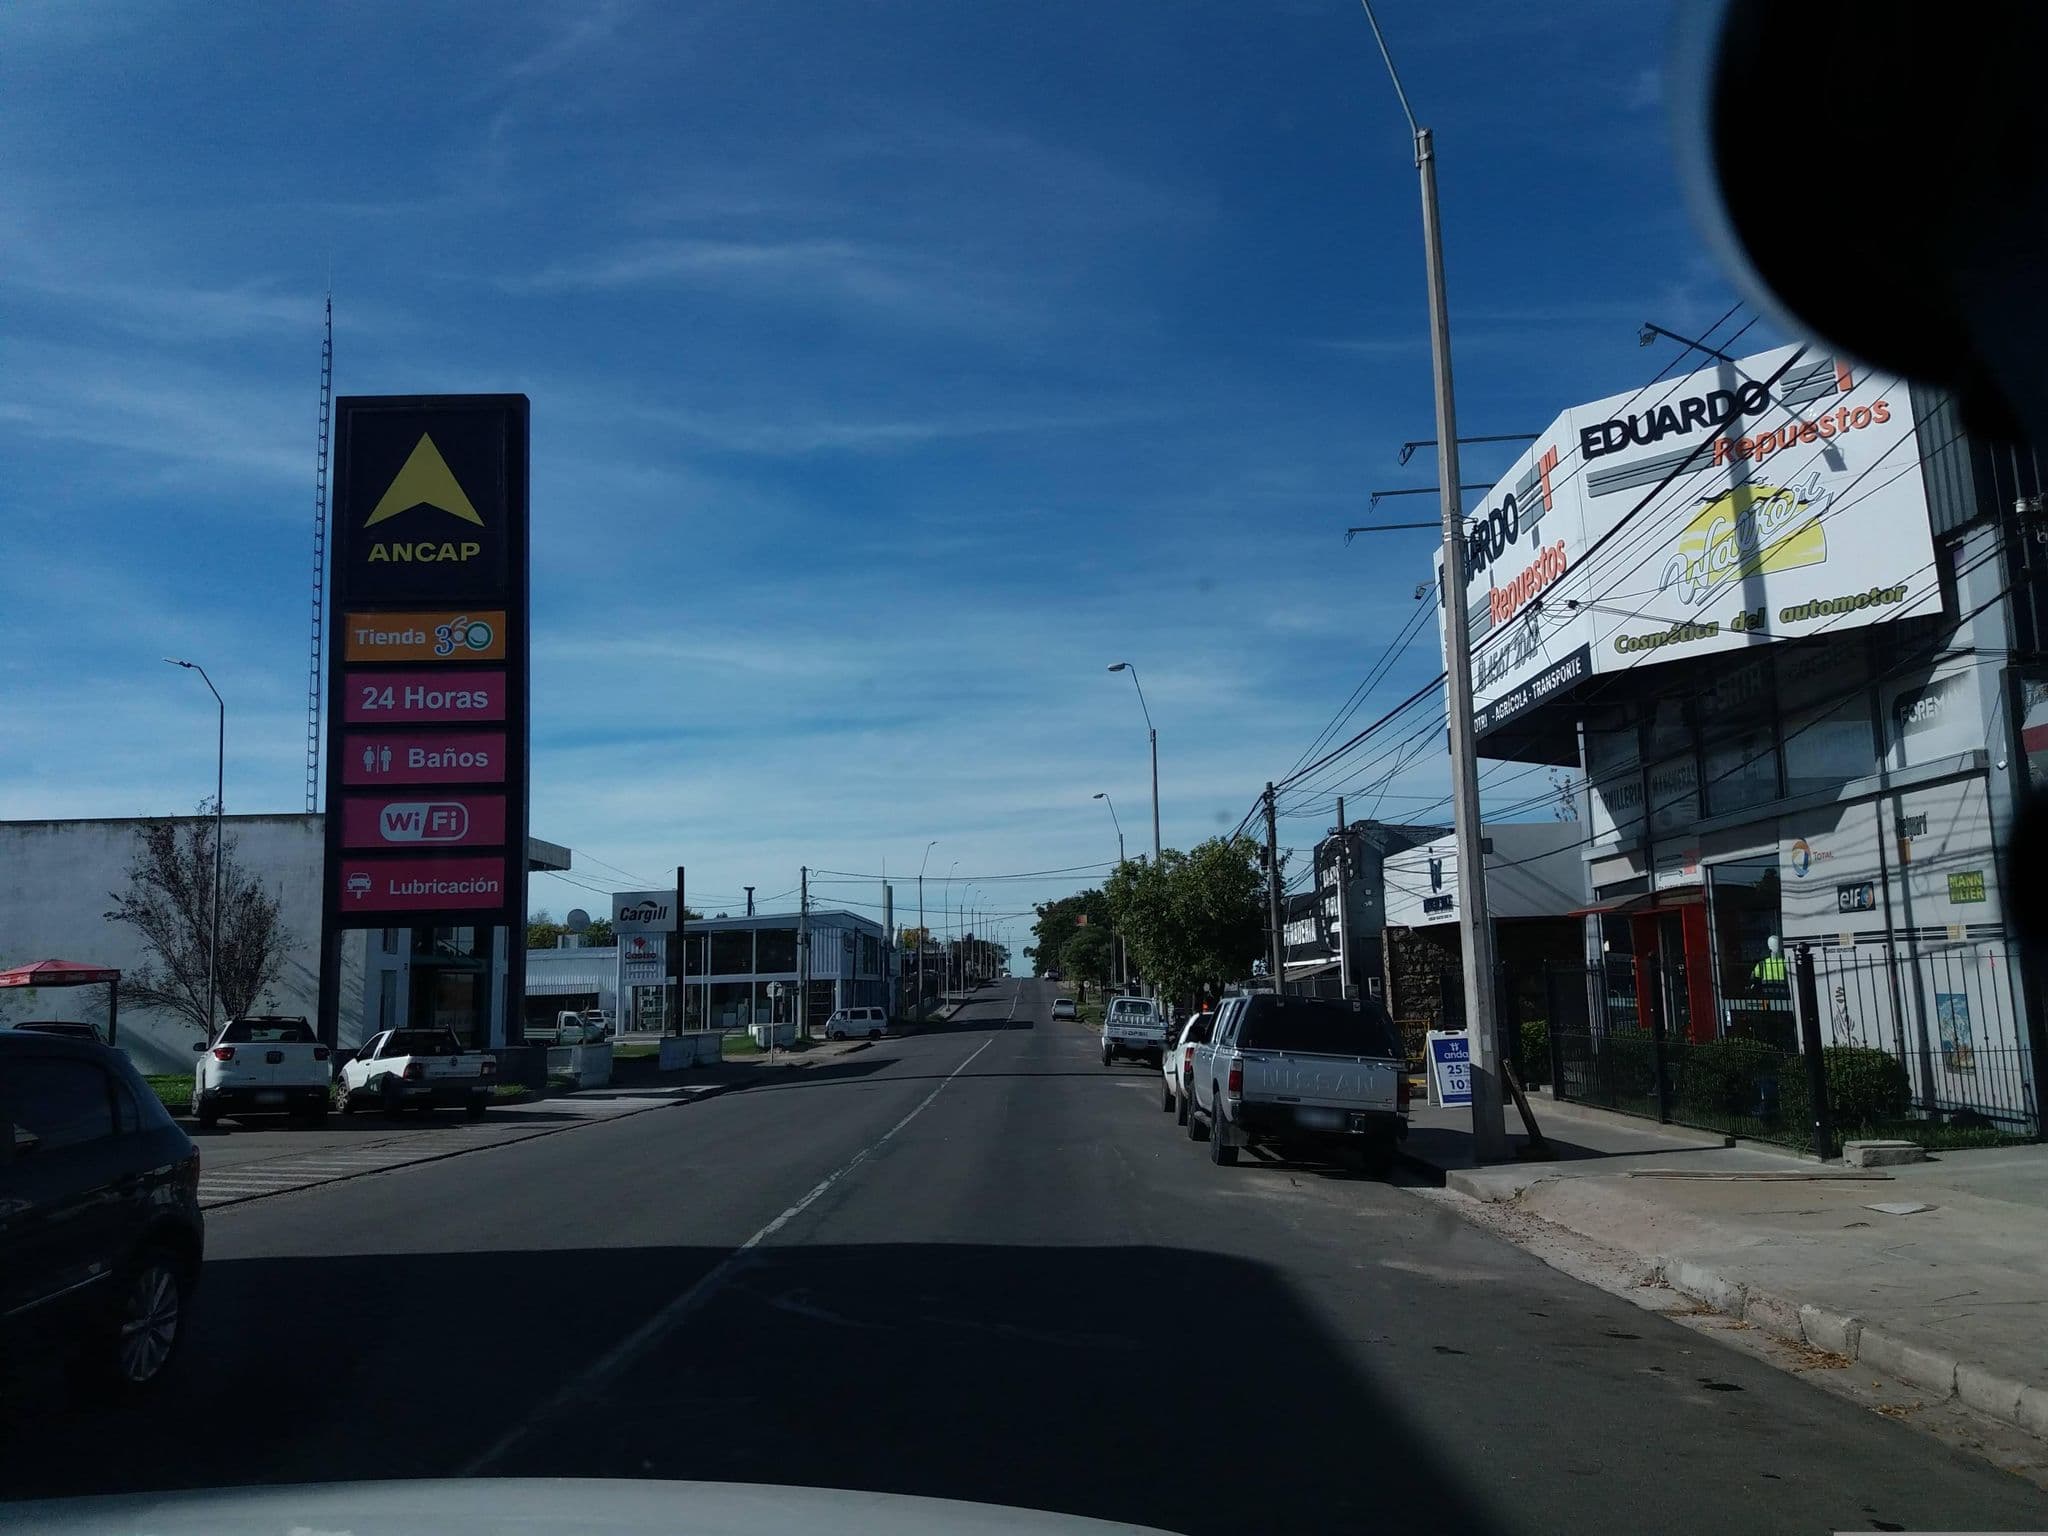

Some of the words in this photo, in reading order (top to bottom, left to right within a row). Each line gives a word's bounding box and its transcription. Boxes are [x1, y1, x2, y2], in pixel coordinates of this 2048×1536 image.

[1580, 380, 1771, 460] EDUARDO
[1713, 399, 1891, 467] Repuestos
[367, 542, 481, 563] ANCAP
[1490, 539, 1568, 628] Repuestos
[1613, 618, 1720, 655] Cosmética
[1730, 605, 1766, 635] del
[1780, 584, 1909, 625] automotor
[355, 627, 427, 647] Tienda
[433, 615, 495, 657] 360
[1531, 656, 1582, 700] TRANSPORTE
[361, 687, 395, 711] 24
[404, 686, 489, 710] Horas
[408, 745, 489, 769] Baños
[388, 876, 499, 896] Lubricación
[1949, 872, 1983, 888] MANN
[1839, 887, 1861, 909] elf
[620, 906, 668, 924] Cargill
[1443, 1049, 1469, 1060] anda
[1263, 1067, 1376, 1097] NISSAN
